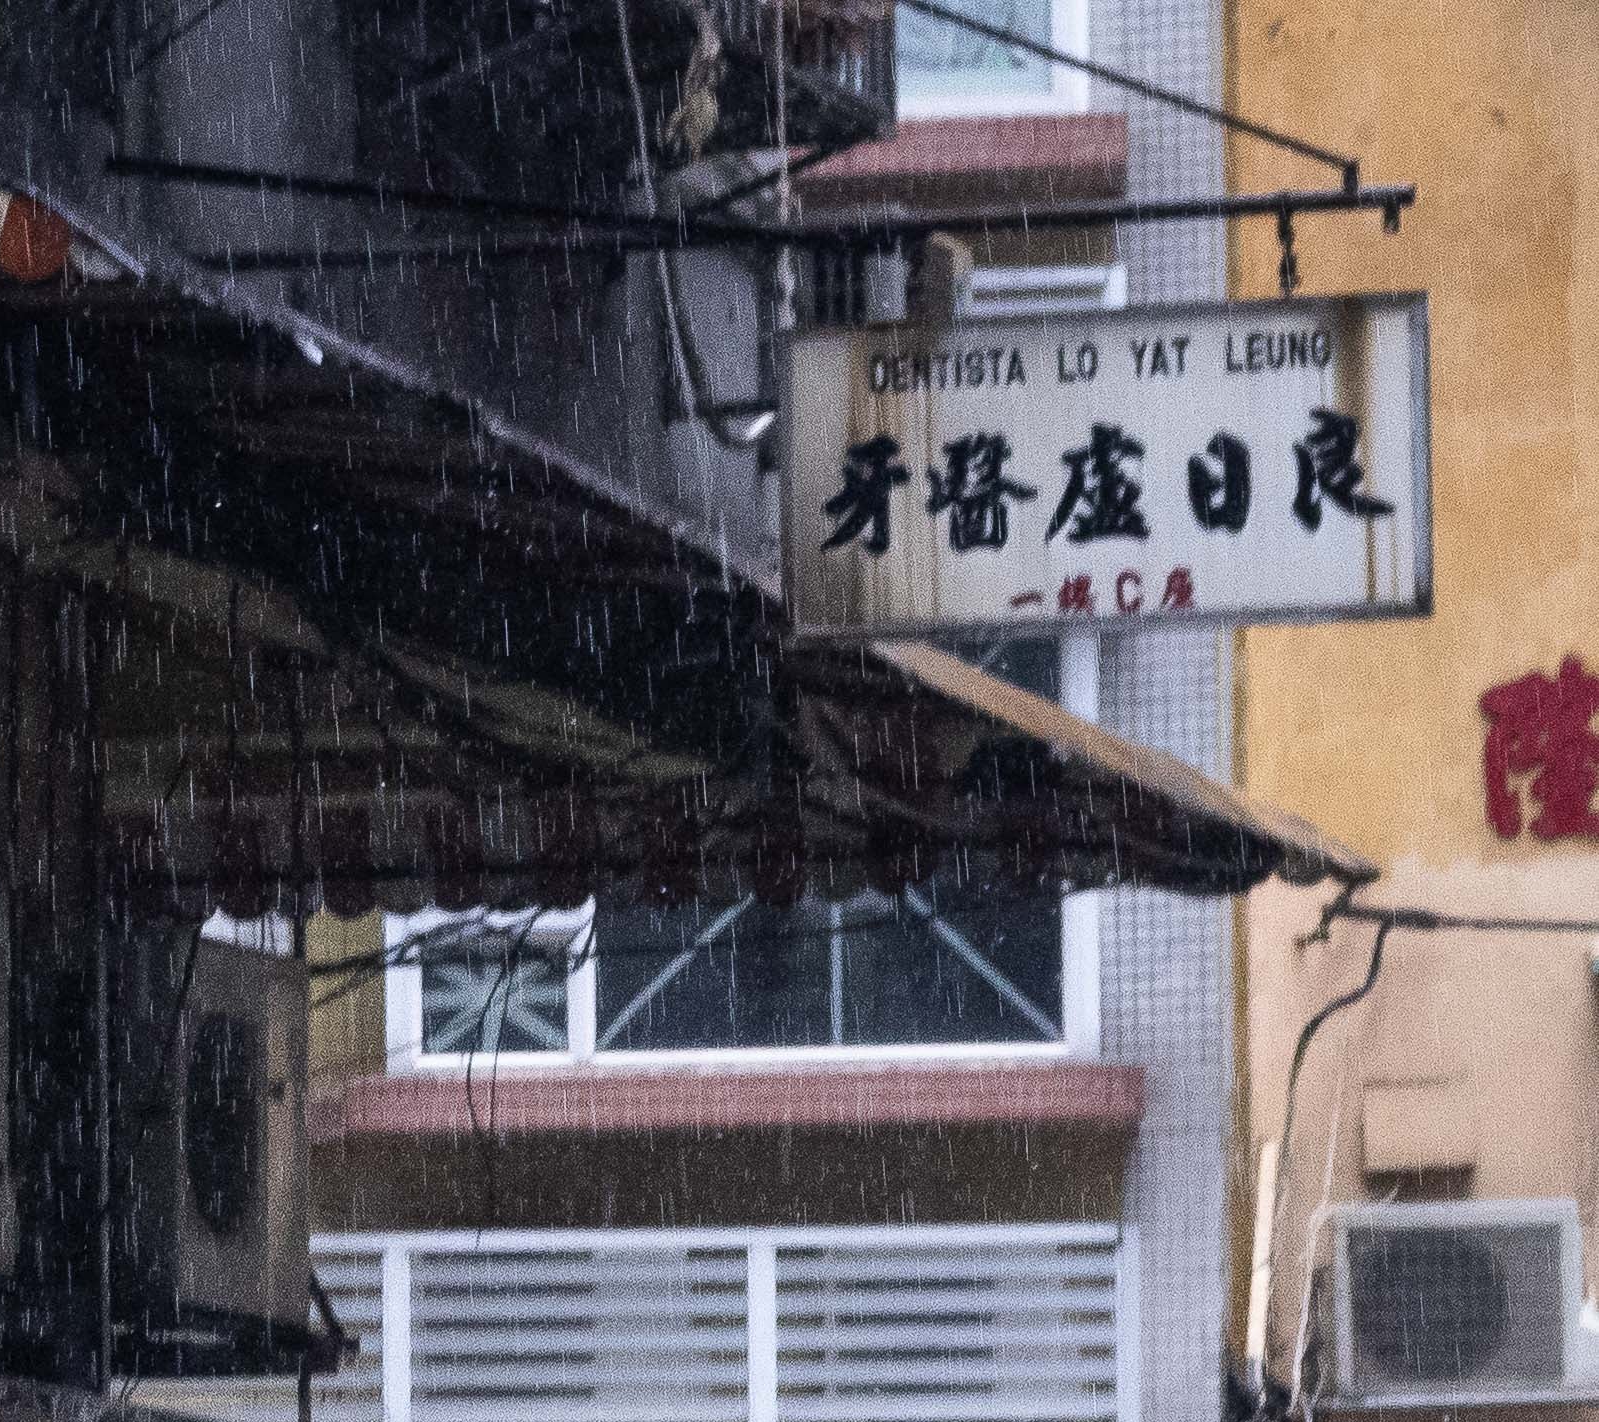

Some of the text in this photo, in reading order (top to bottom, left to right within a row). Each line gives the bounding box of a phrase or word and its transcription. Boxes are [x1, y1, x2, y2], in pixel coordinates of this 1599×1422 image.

[868, 329, 1332, 393] DENTISTA LO YAT LEUNG
